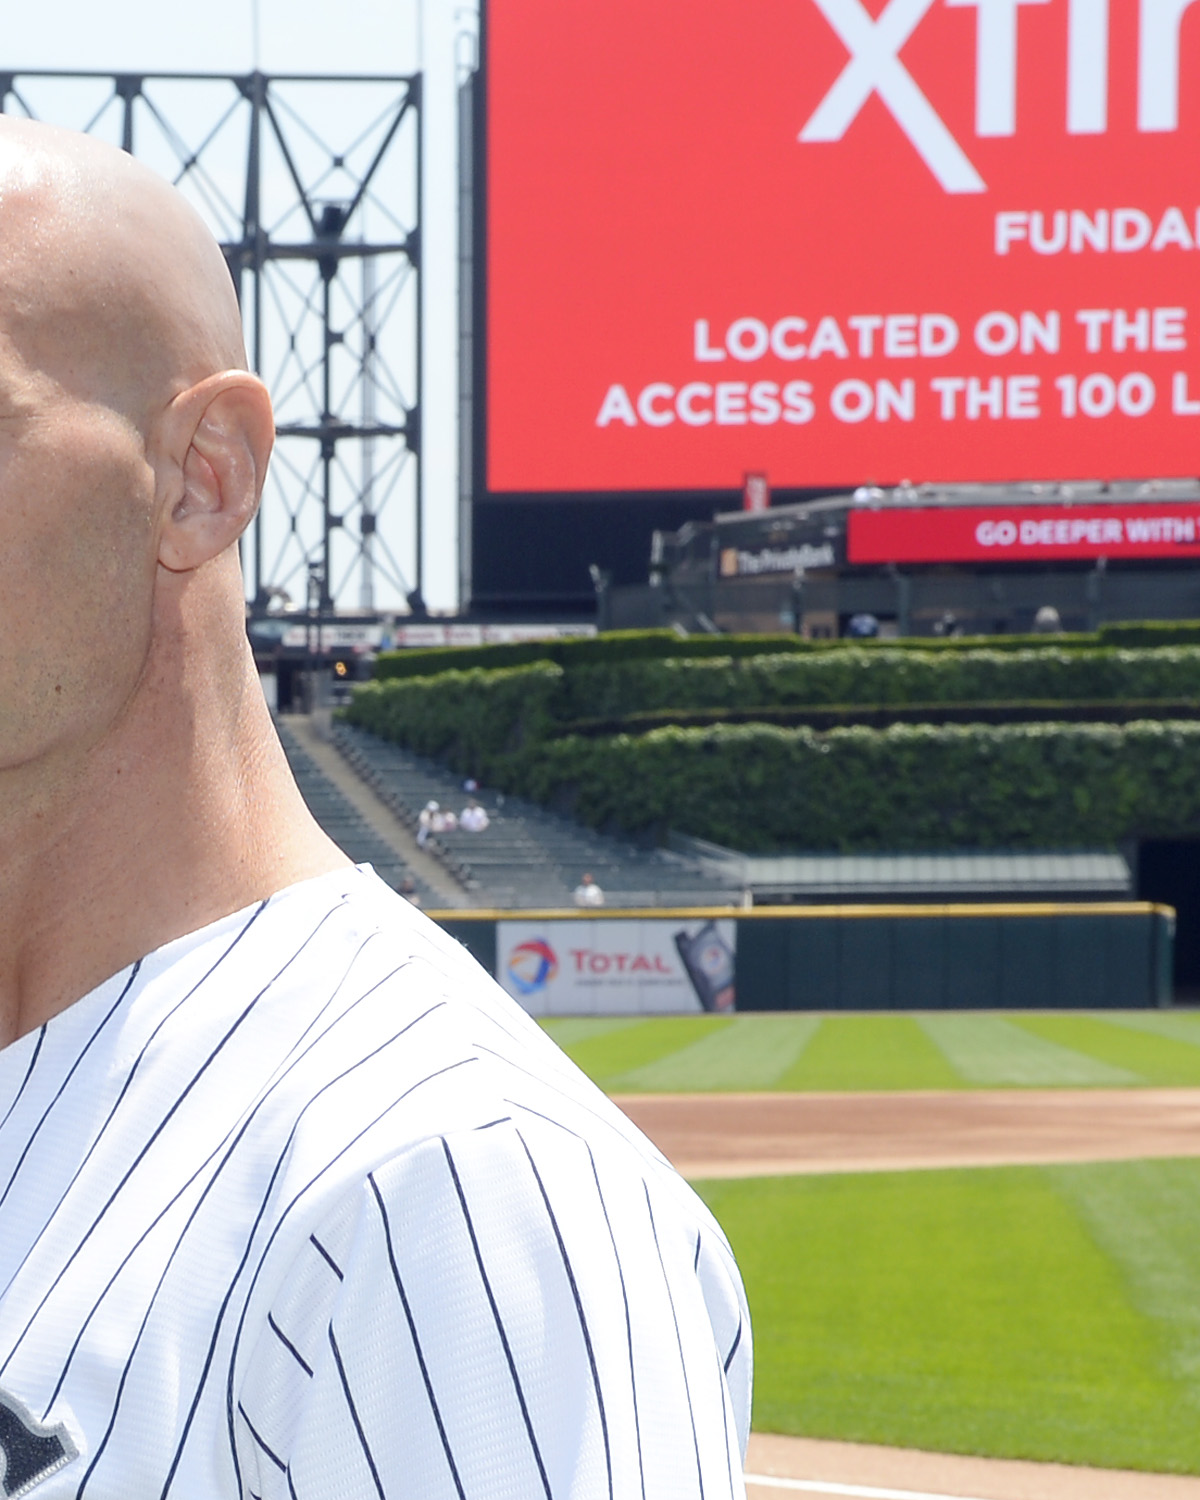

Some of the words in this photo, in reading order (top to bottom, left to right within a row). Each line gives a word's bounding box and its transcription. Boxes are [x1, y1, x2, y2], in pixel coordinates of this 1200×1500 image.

[993, 206, 1200, 256] FUNDA
[693, 313, 960, 363] LOCATED
[974, 310, 1061, 357] ON
[1075, 306, 1187, 353] THE
[595, 379, 816, 428] ACCESS
[829, 377, 915, 424] ON
[930, 374, 1041, 421] THE
[1055, 371, 1156, 419] 100
[975, 519, 1017, 546] GO
[1019, 518, 1123, 545] DEEPER
[1126, 516, 1195, 543] WITH
